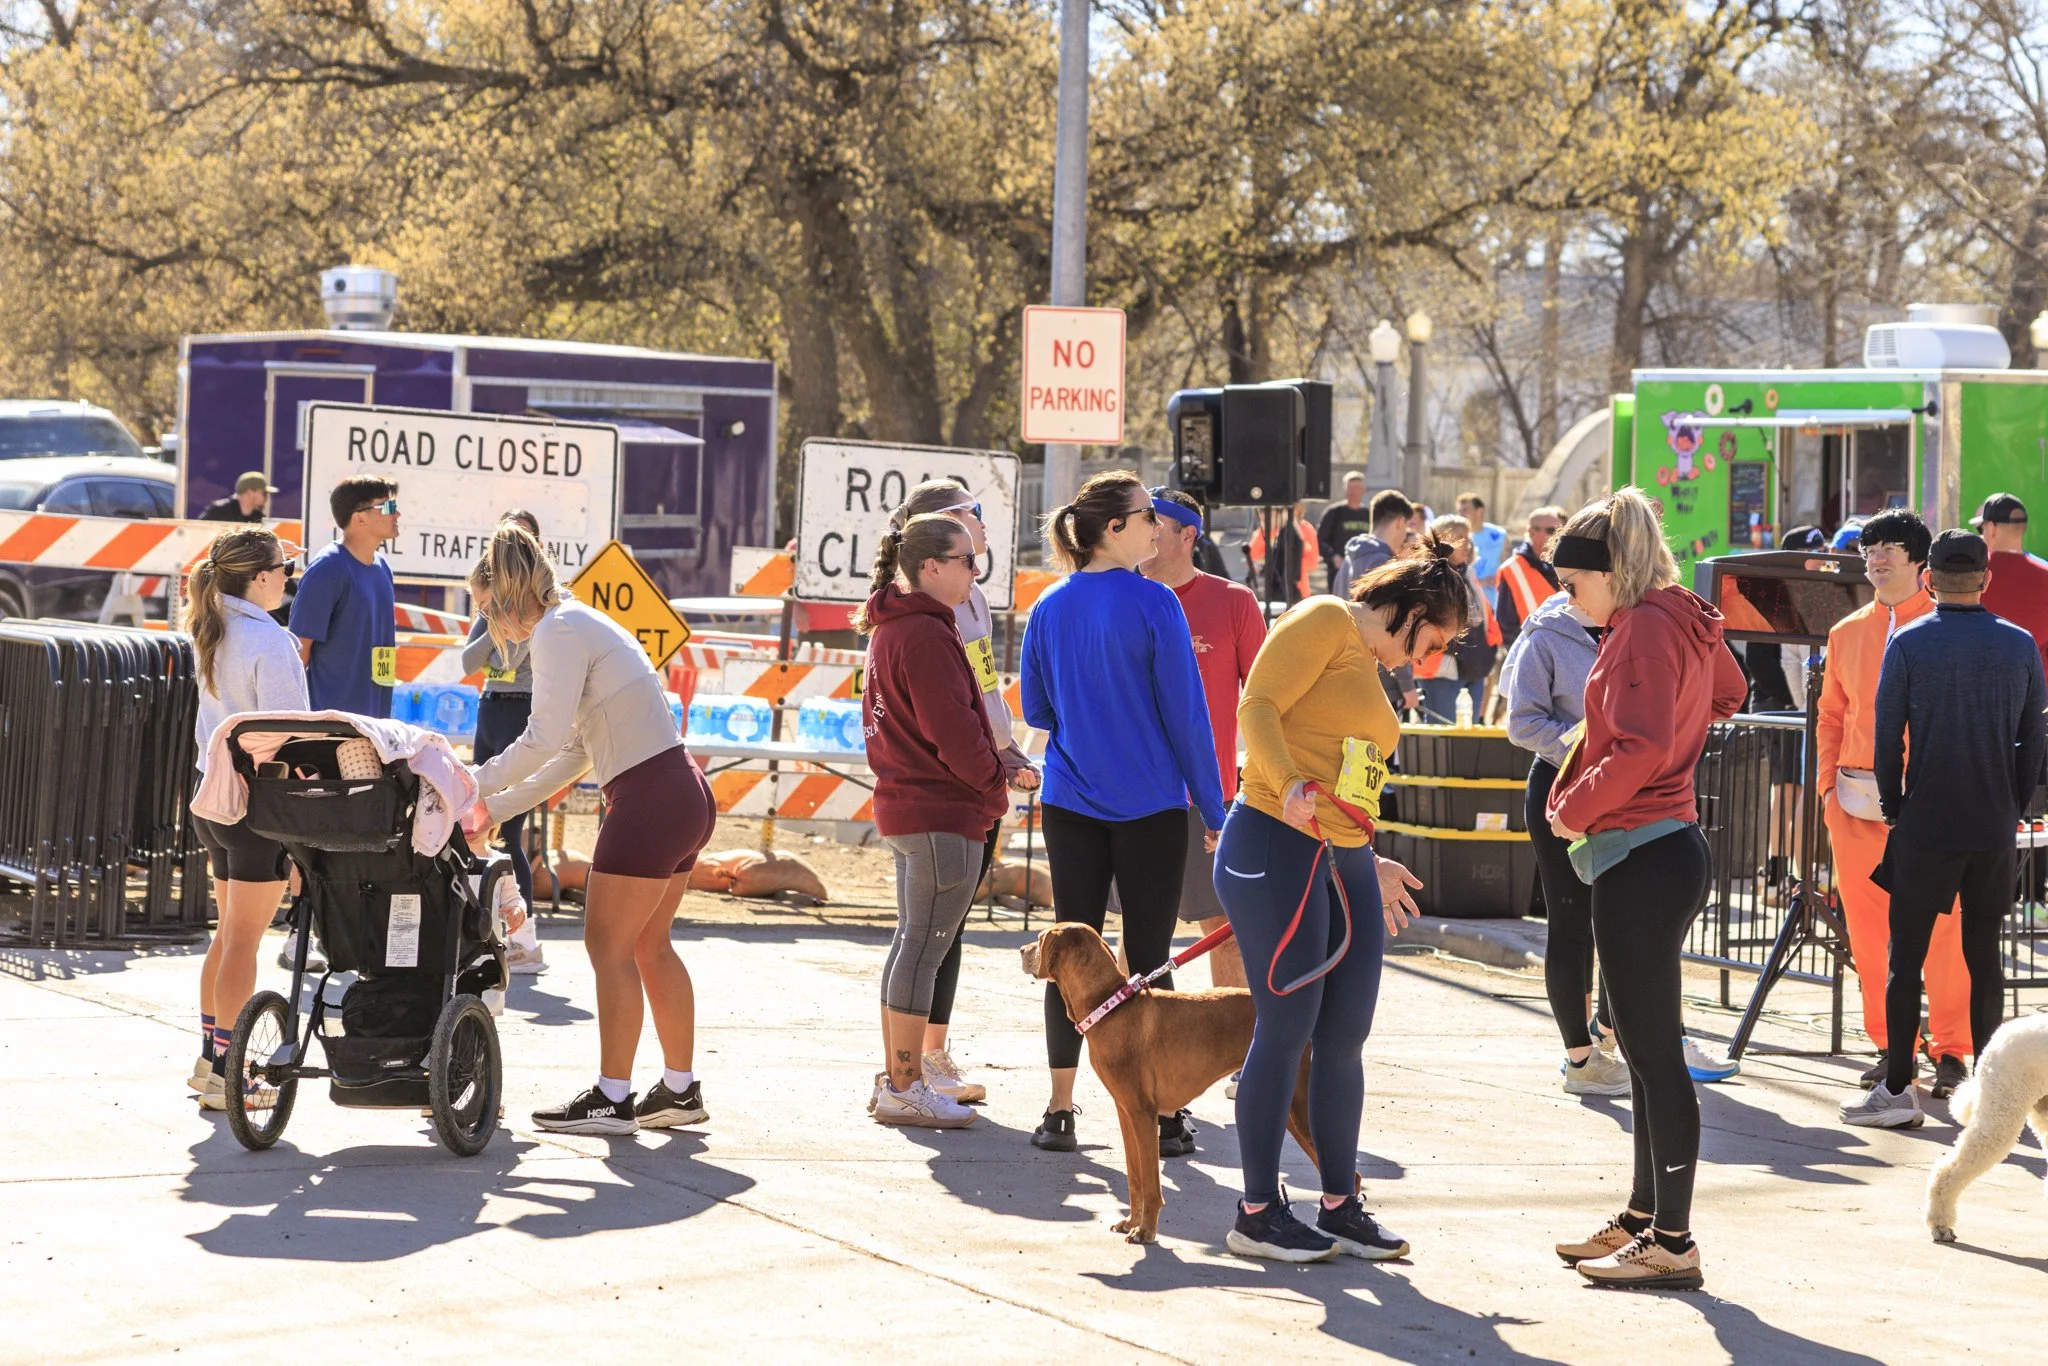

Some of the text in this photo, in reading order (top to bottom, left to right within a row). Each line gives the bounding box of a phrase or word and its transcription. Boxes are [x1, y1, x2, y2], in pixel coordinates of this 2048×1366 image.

[1053, 339, 1095, 369] NO
[1030, 386, 1116, 413] PARKING
[348, 426, 582, 478] ROAD CLOSED
[845, 467, 971, 513] RO
[419, 532, 491, 560] TRAFF
[547, 541, 589, 567] NLY
[592, 581, 634, 612] NO
[377, 662, 390, 677] 204
[587, 1105, 616, 1119] HOKA
